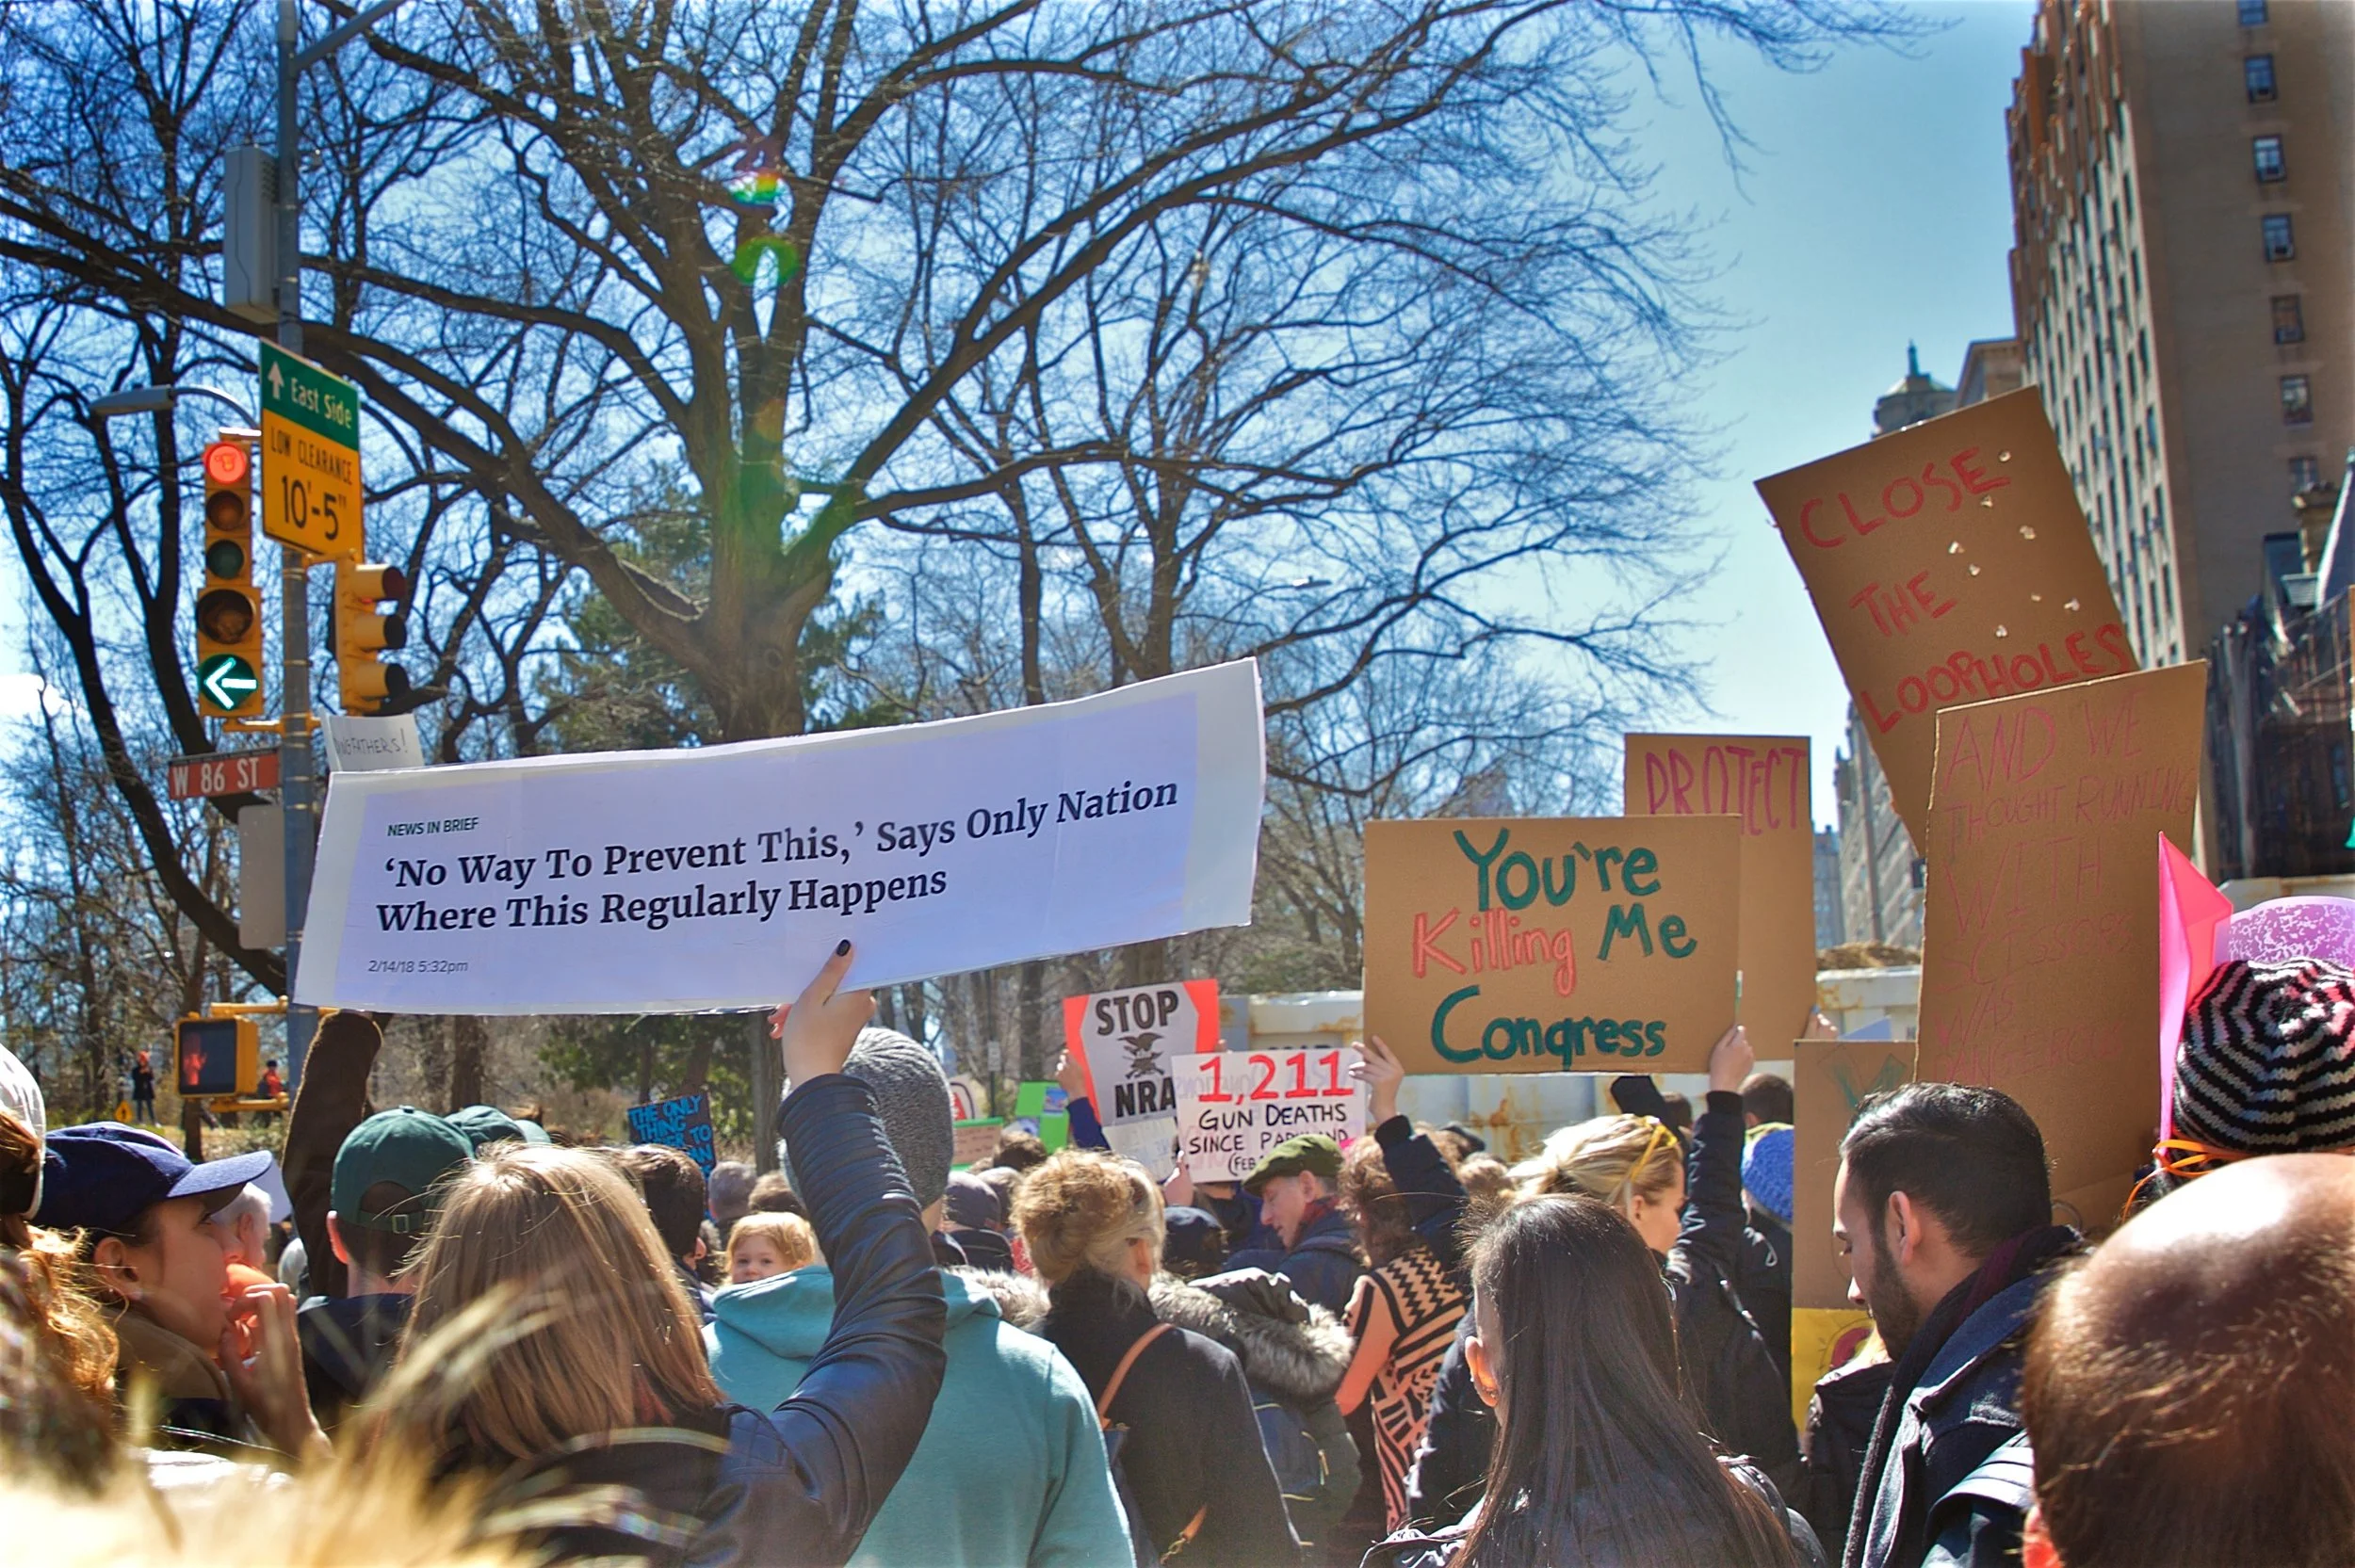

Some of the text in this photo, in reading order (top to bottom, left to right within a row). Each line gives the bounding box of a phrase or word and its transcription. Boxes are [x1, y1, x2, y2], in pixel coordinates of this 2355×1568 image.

[290, 378, 352, 429] East Side
[270, 427, 353, 486] LOW CLEARANCE
[1799, 446, 2010, 549] CLOSE
[1849, 571, 1957, 637] THE
[1860, 623, 2130, 735] LOOPHOLES
[1943, 688, 2145, 792] AND WE
[172, 756, 260, 797] W 86 ST
[1644, 745, 1809, 836] PROTECT
[387, 816, 479, 836] NEWS IN BRIEF
[459, 854, 536, 890] Way
[545, 848, 593, 880] To
[604, 835, 747, 875] Prevent
[876, 820, 956, 858] Says
[966, 797, 1049, 840] Only
[1055, 780, 1179, 825] Nation
[1943, 767, 2196, 860] THOUGHT RUNNING
[1453, 827, 1662, 912] You're
[1943, 837, 2103, 938] WITH
[377, 869, 948, 932] Where This Regularly Happens
[367, 960, 469, 976] 2/14/18 5:32pm
[1413, 902, 1697, 996] Killing Me
[1095, 990, 1179, 1037] STOP
[1430, 984, 1667, 1071] Congress
[1114, 1076, 1177, 1119] NRA
[1197, 1050, 1355, 1106] 1,211
[627, 1094, 702, 1131] THE ONLY
[638, 1115, 687, 1141] THING
[690, 1123, 713, 1144] TO
[1198, 1103, 1348, 1132] GUN DEATHS
[1189, 1136, 1245, 1155] SINCE
